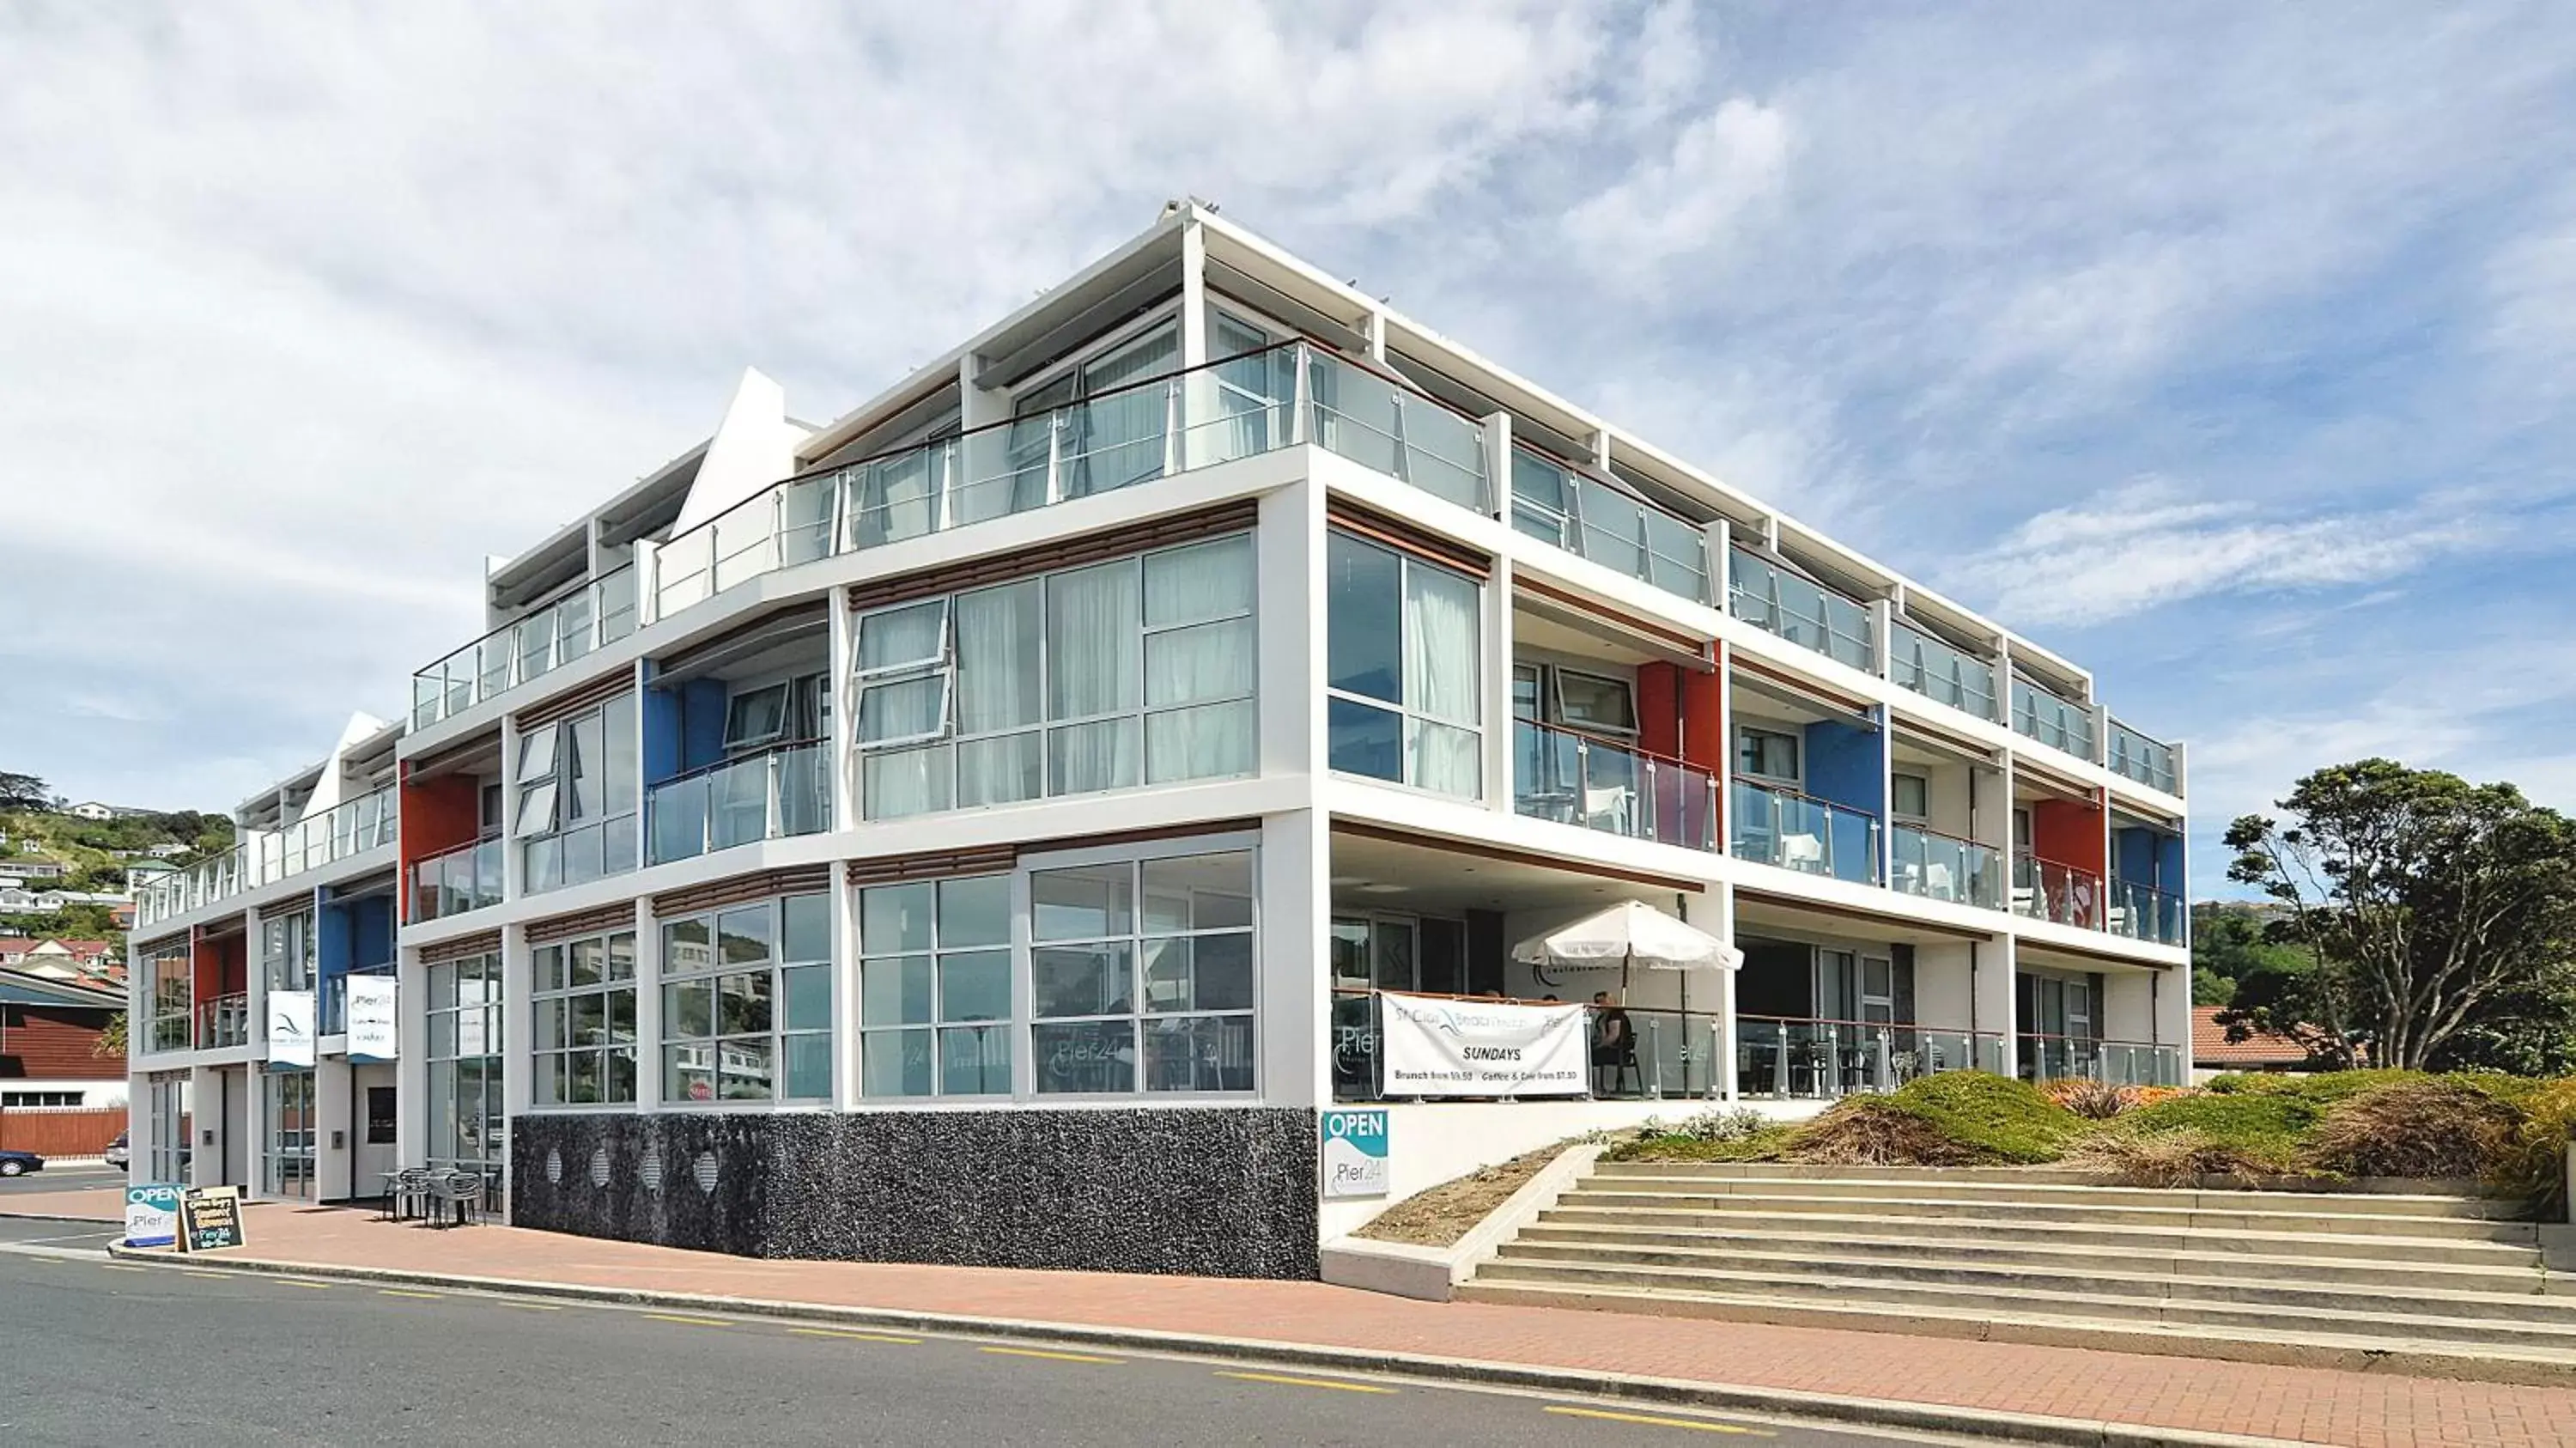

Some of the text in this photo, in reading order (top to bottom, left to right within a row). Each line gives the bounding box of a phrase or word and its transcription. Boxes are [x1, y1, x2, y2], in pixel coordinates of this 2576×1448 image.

[1463, 1047, 1521, 1061] SUNDAYS
[1394, 1070, 1428, 1080] Brunch
[1482, 1072, 1509, 1081] Coffee
[1328, 1113, 1384, 1136] OPEN
[1337, 1159, 1382, 1181] Pier24
[129, 1187, 183, 1202] OPEN
